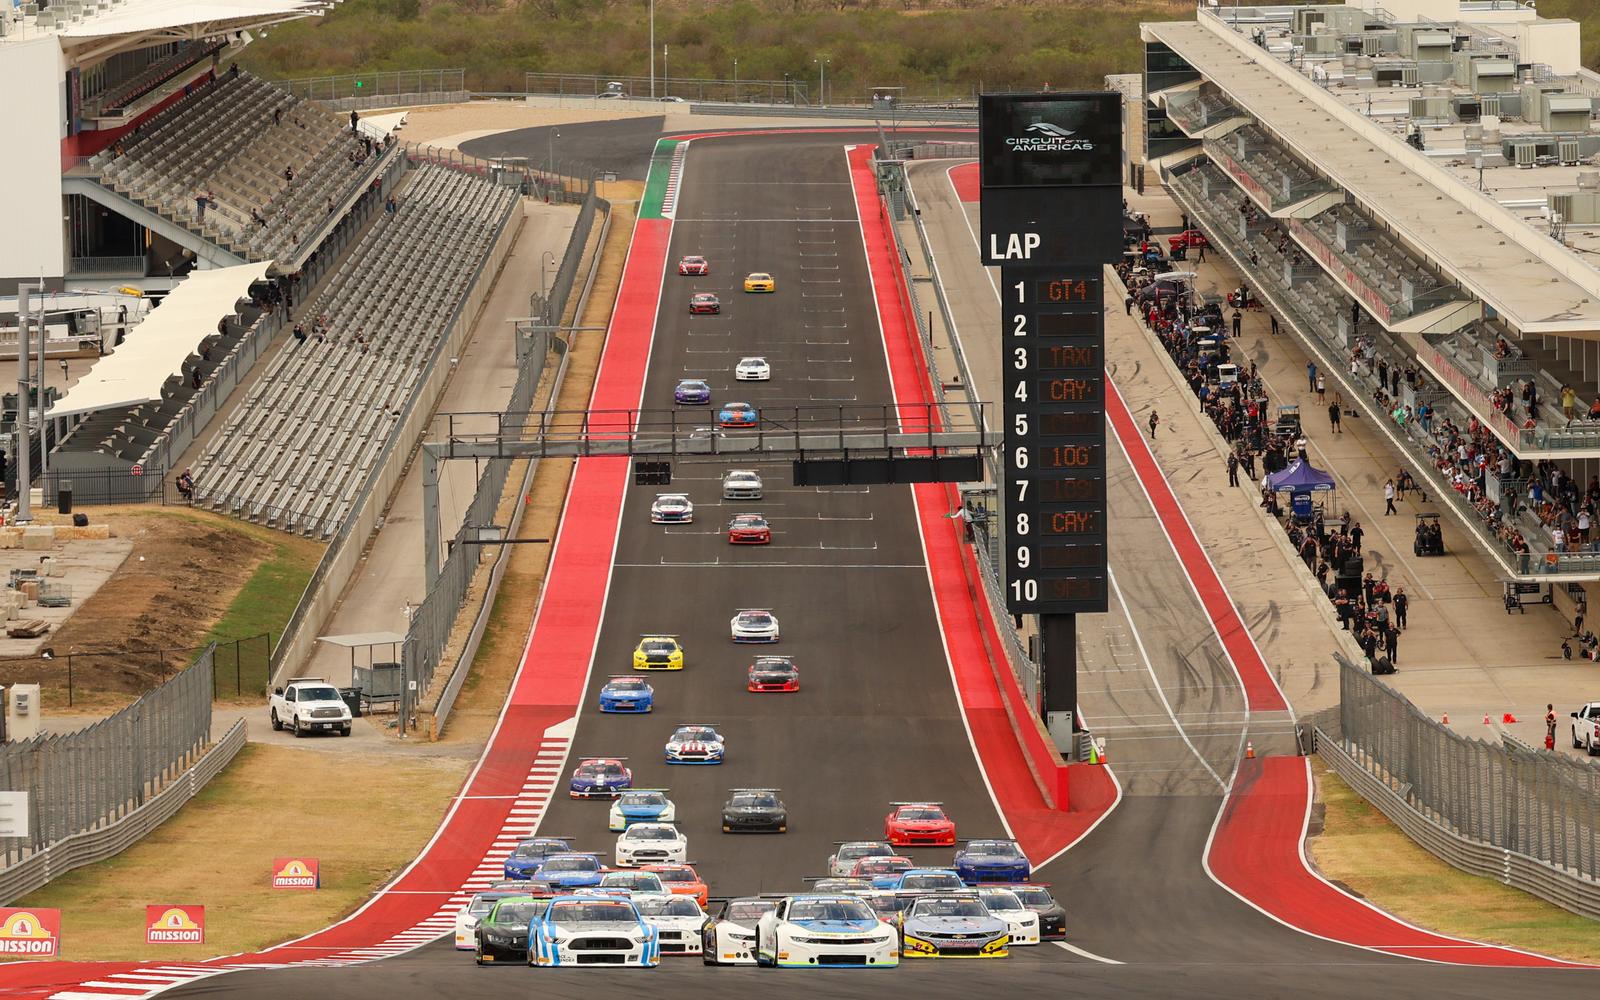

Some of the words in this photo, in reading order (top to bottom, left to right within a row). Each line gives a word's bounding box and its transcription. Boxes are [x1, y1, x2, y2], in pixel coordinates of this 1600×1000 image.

[1006, 137, 1065, 145] CIRCUIT
[1012, 143, 1093, 152] AMERICAS
[990, 233, 1041, 260] LAP
[1014, 281, 1025, 303] 1
[1013, 314, 1027, 337] 2
[1014, 347, 1028, 370] 3
[1014, 380, 1028, 402] 4
[1015, 413, 1029, 436] 5
[1015, 446, 1029, 469] 6
[1016, 480, 1029, 502] 7
[1016, 513, 1030, 535] 8
[1017, 546, 1031, 569] 9
[1011, 579, 1038, 602] 10
